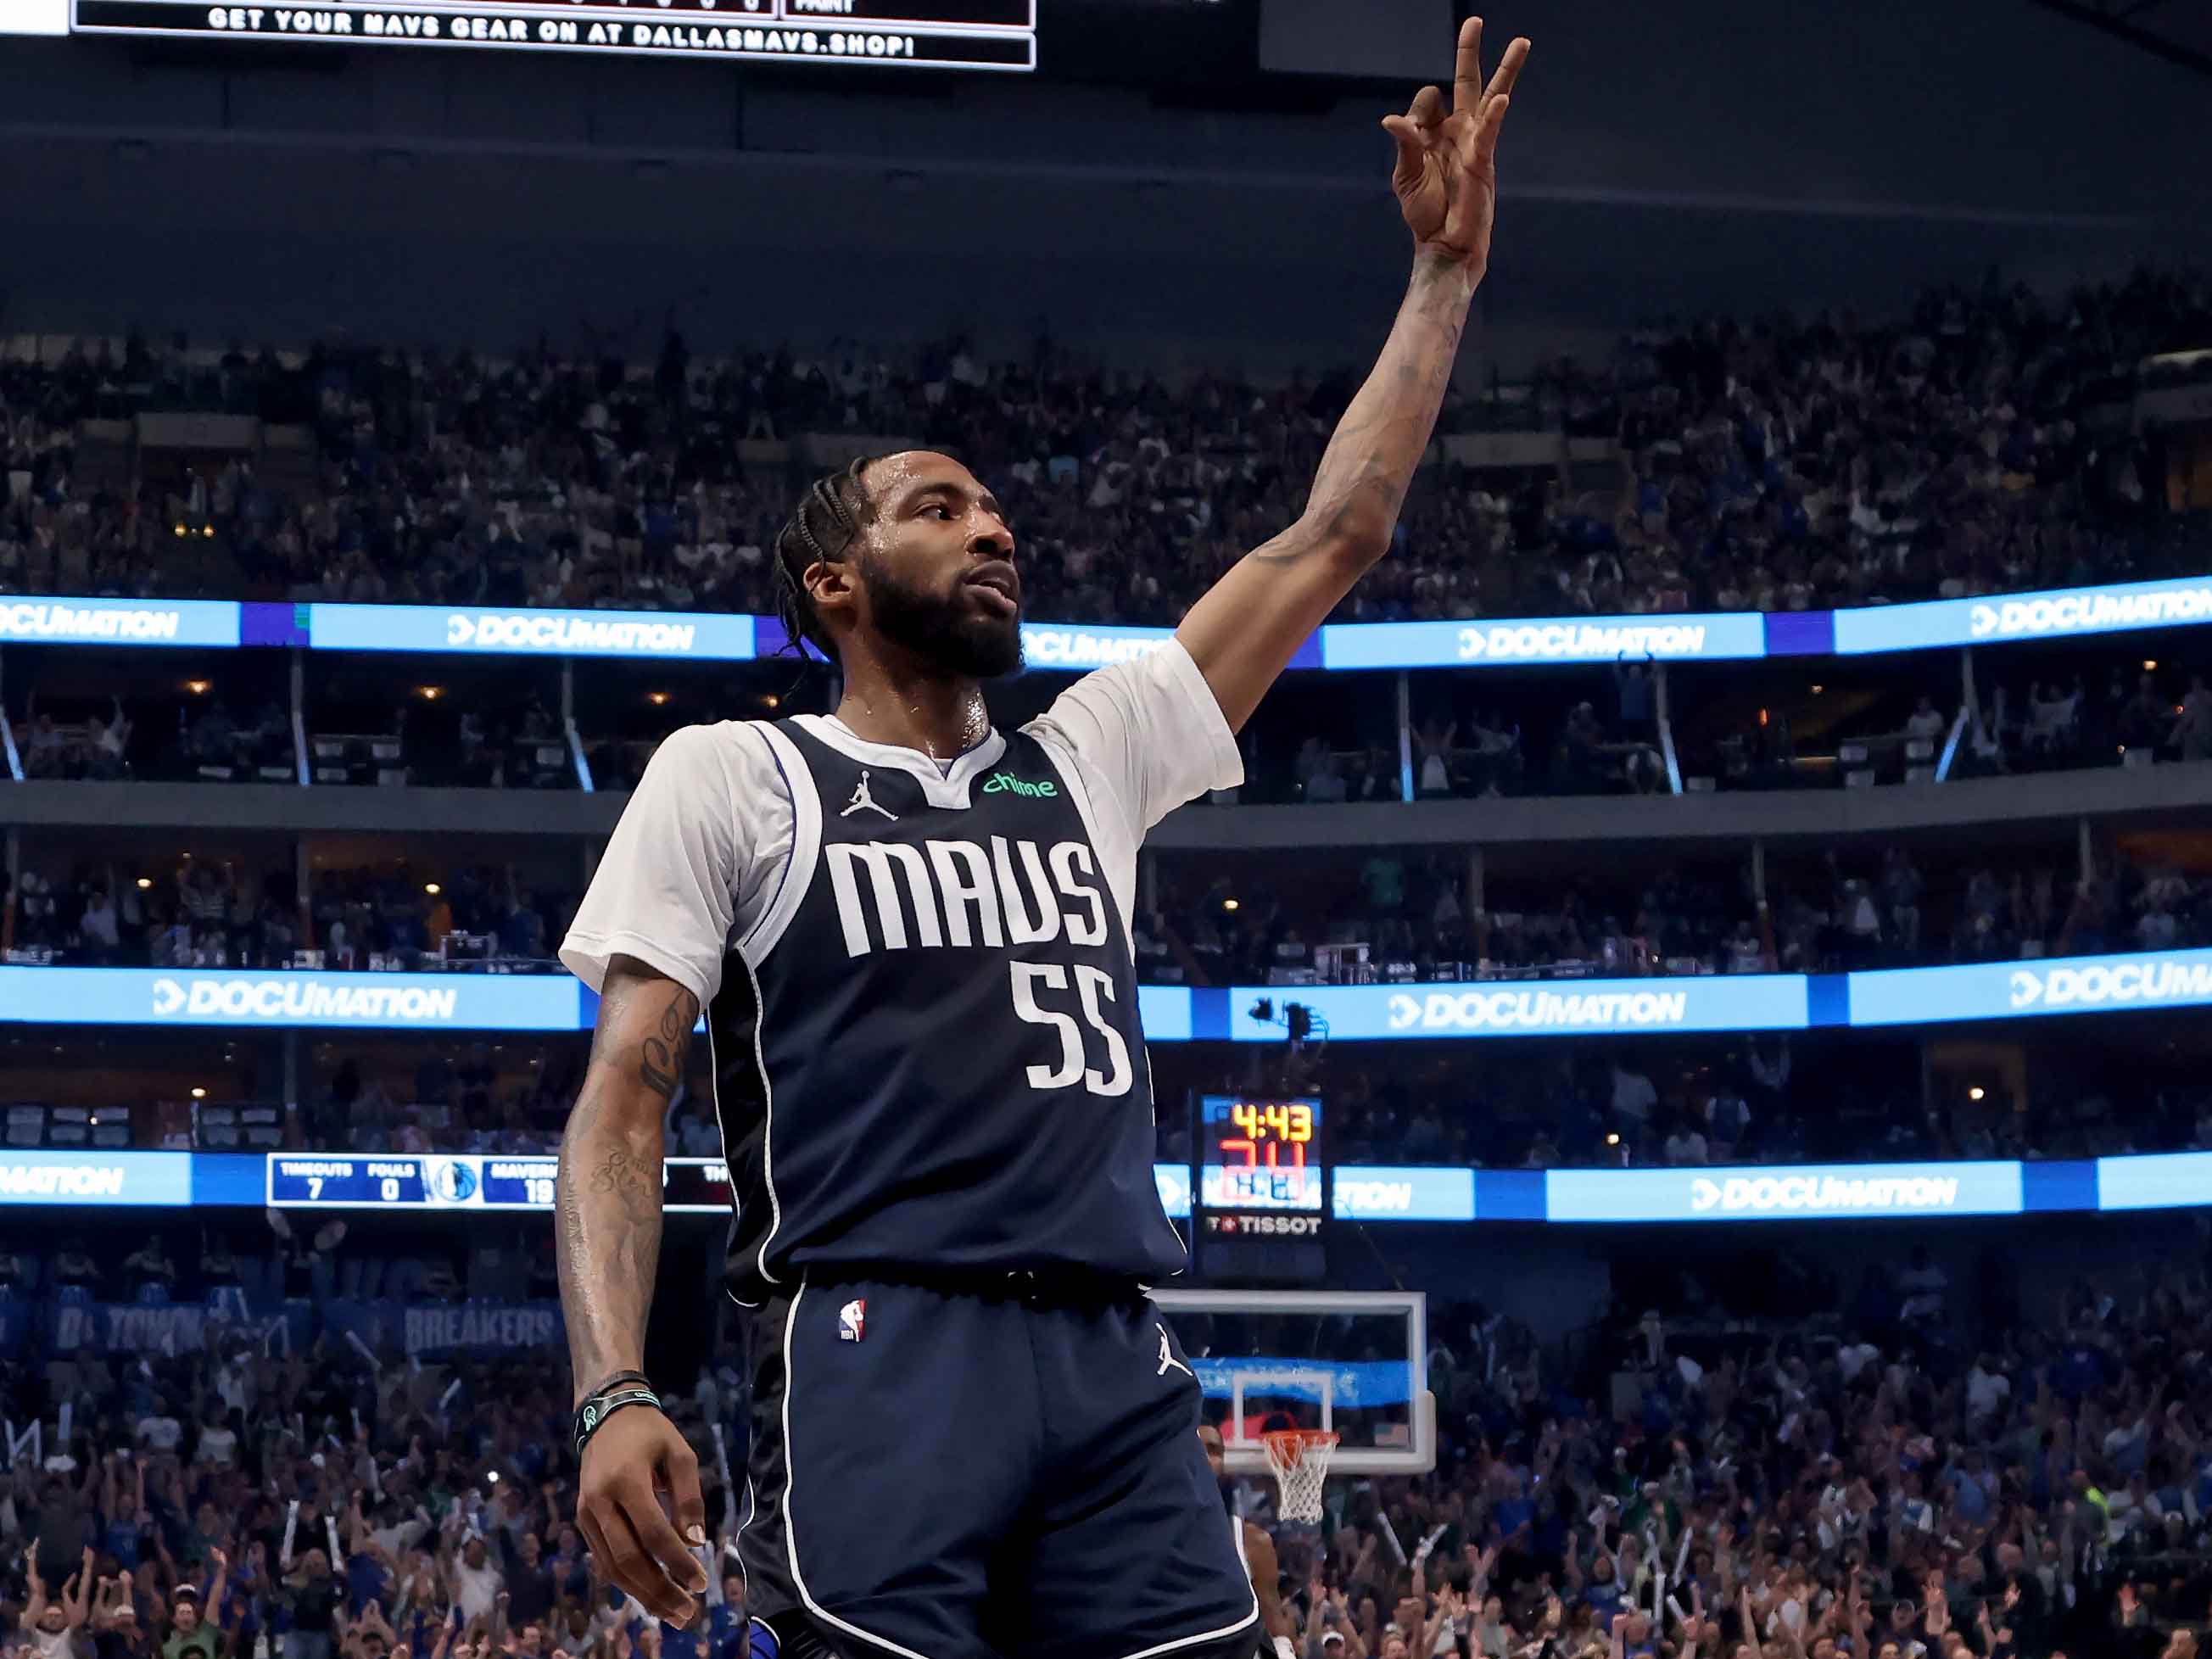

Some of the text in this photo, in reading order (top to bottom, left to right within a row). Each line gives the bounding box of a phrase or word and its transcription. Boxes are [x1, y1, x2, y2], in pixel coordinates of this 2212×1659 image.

[209, 7, 914, 58] GET YOUR MAVS GEAR ON AT DALLASMAVS.SHOP!
[0, 603, 178, 638] CUMATION
[1999, 589, 2212, 634] DOCUMATION
[478, 615, 695, 651] DOCUMATION
[1488, 625, 1705, 658] DOCUMATION
[983, 773, 1058, 798] chime
[825, 835, 1108, 958] MAVS
[186, 979, 457, 1019] DOCUMATION
[2044, 961, 2212, 1004] DOCUM
[1422, 991, 1687, 1027] DOCUMATION
[1010, 960, 1133, 1098] 55
[1234, 1104, 1312, 1142] 4:43
[281, 1162, 415, 1177] TIMEOUTS FOULS
[308, 1177, 323, 1199] 7
[381, 1178, 399, 1201] 0
[1722, 1176, 1958, 1209] DOCUMATION
[1238, 1216, 1321, 1234] TISSOT
[405, 1307, 556, 1353] BREAKERS
